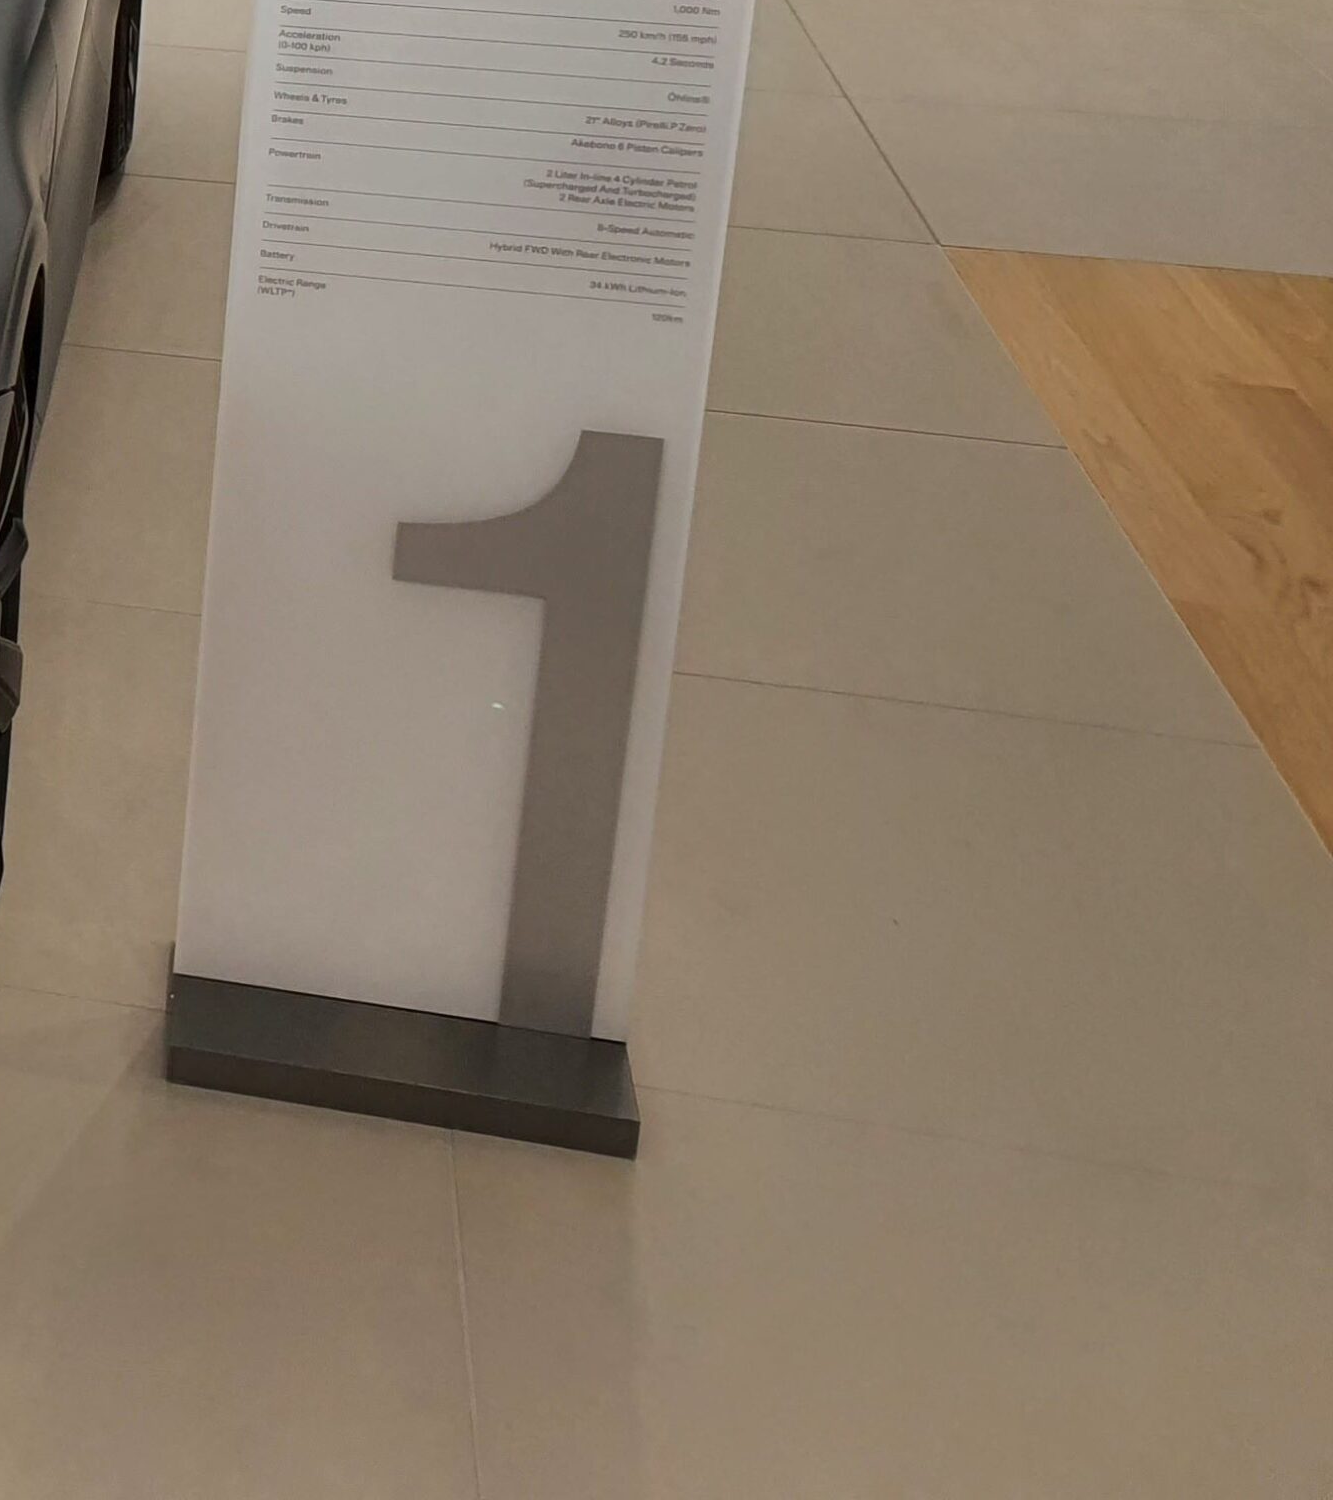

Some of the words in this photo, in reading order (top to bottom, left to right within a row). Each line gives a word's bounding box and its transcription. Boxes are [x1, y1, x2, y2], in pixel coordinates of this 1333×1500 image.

[280, 5, 312, 16] Speed
[279, 29, 341, 42] Acceleration
[309, 42, 331, 53] kph)
[276, 63, 333, 76] Suspension
[274, 91, 310, 102] Wheels
[311, 94, 319, 103] &
[321, 94, 348, 105] Tyres
[271, 114, 304, 125] Brakes
[268, 148, 322, 160] Powertrain
[546, 169, 553, 178] 2
[266, 193, 329, 207] Transmission
[559, 193, 566, 202] 2
[262, 220, 310, 232] Drivetrain
[489, 242, 523, 253] Hybrid
[260, 249, 295, 262] Battery
[258, 275, 294, 287] Electric
[296, 278, 326, 290] Range
[392, 429, 666, 1040] 1
